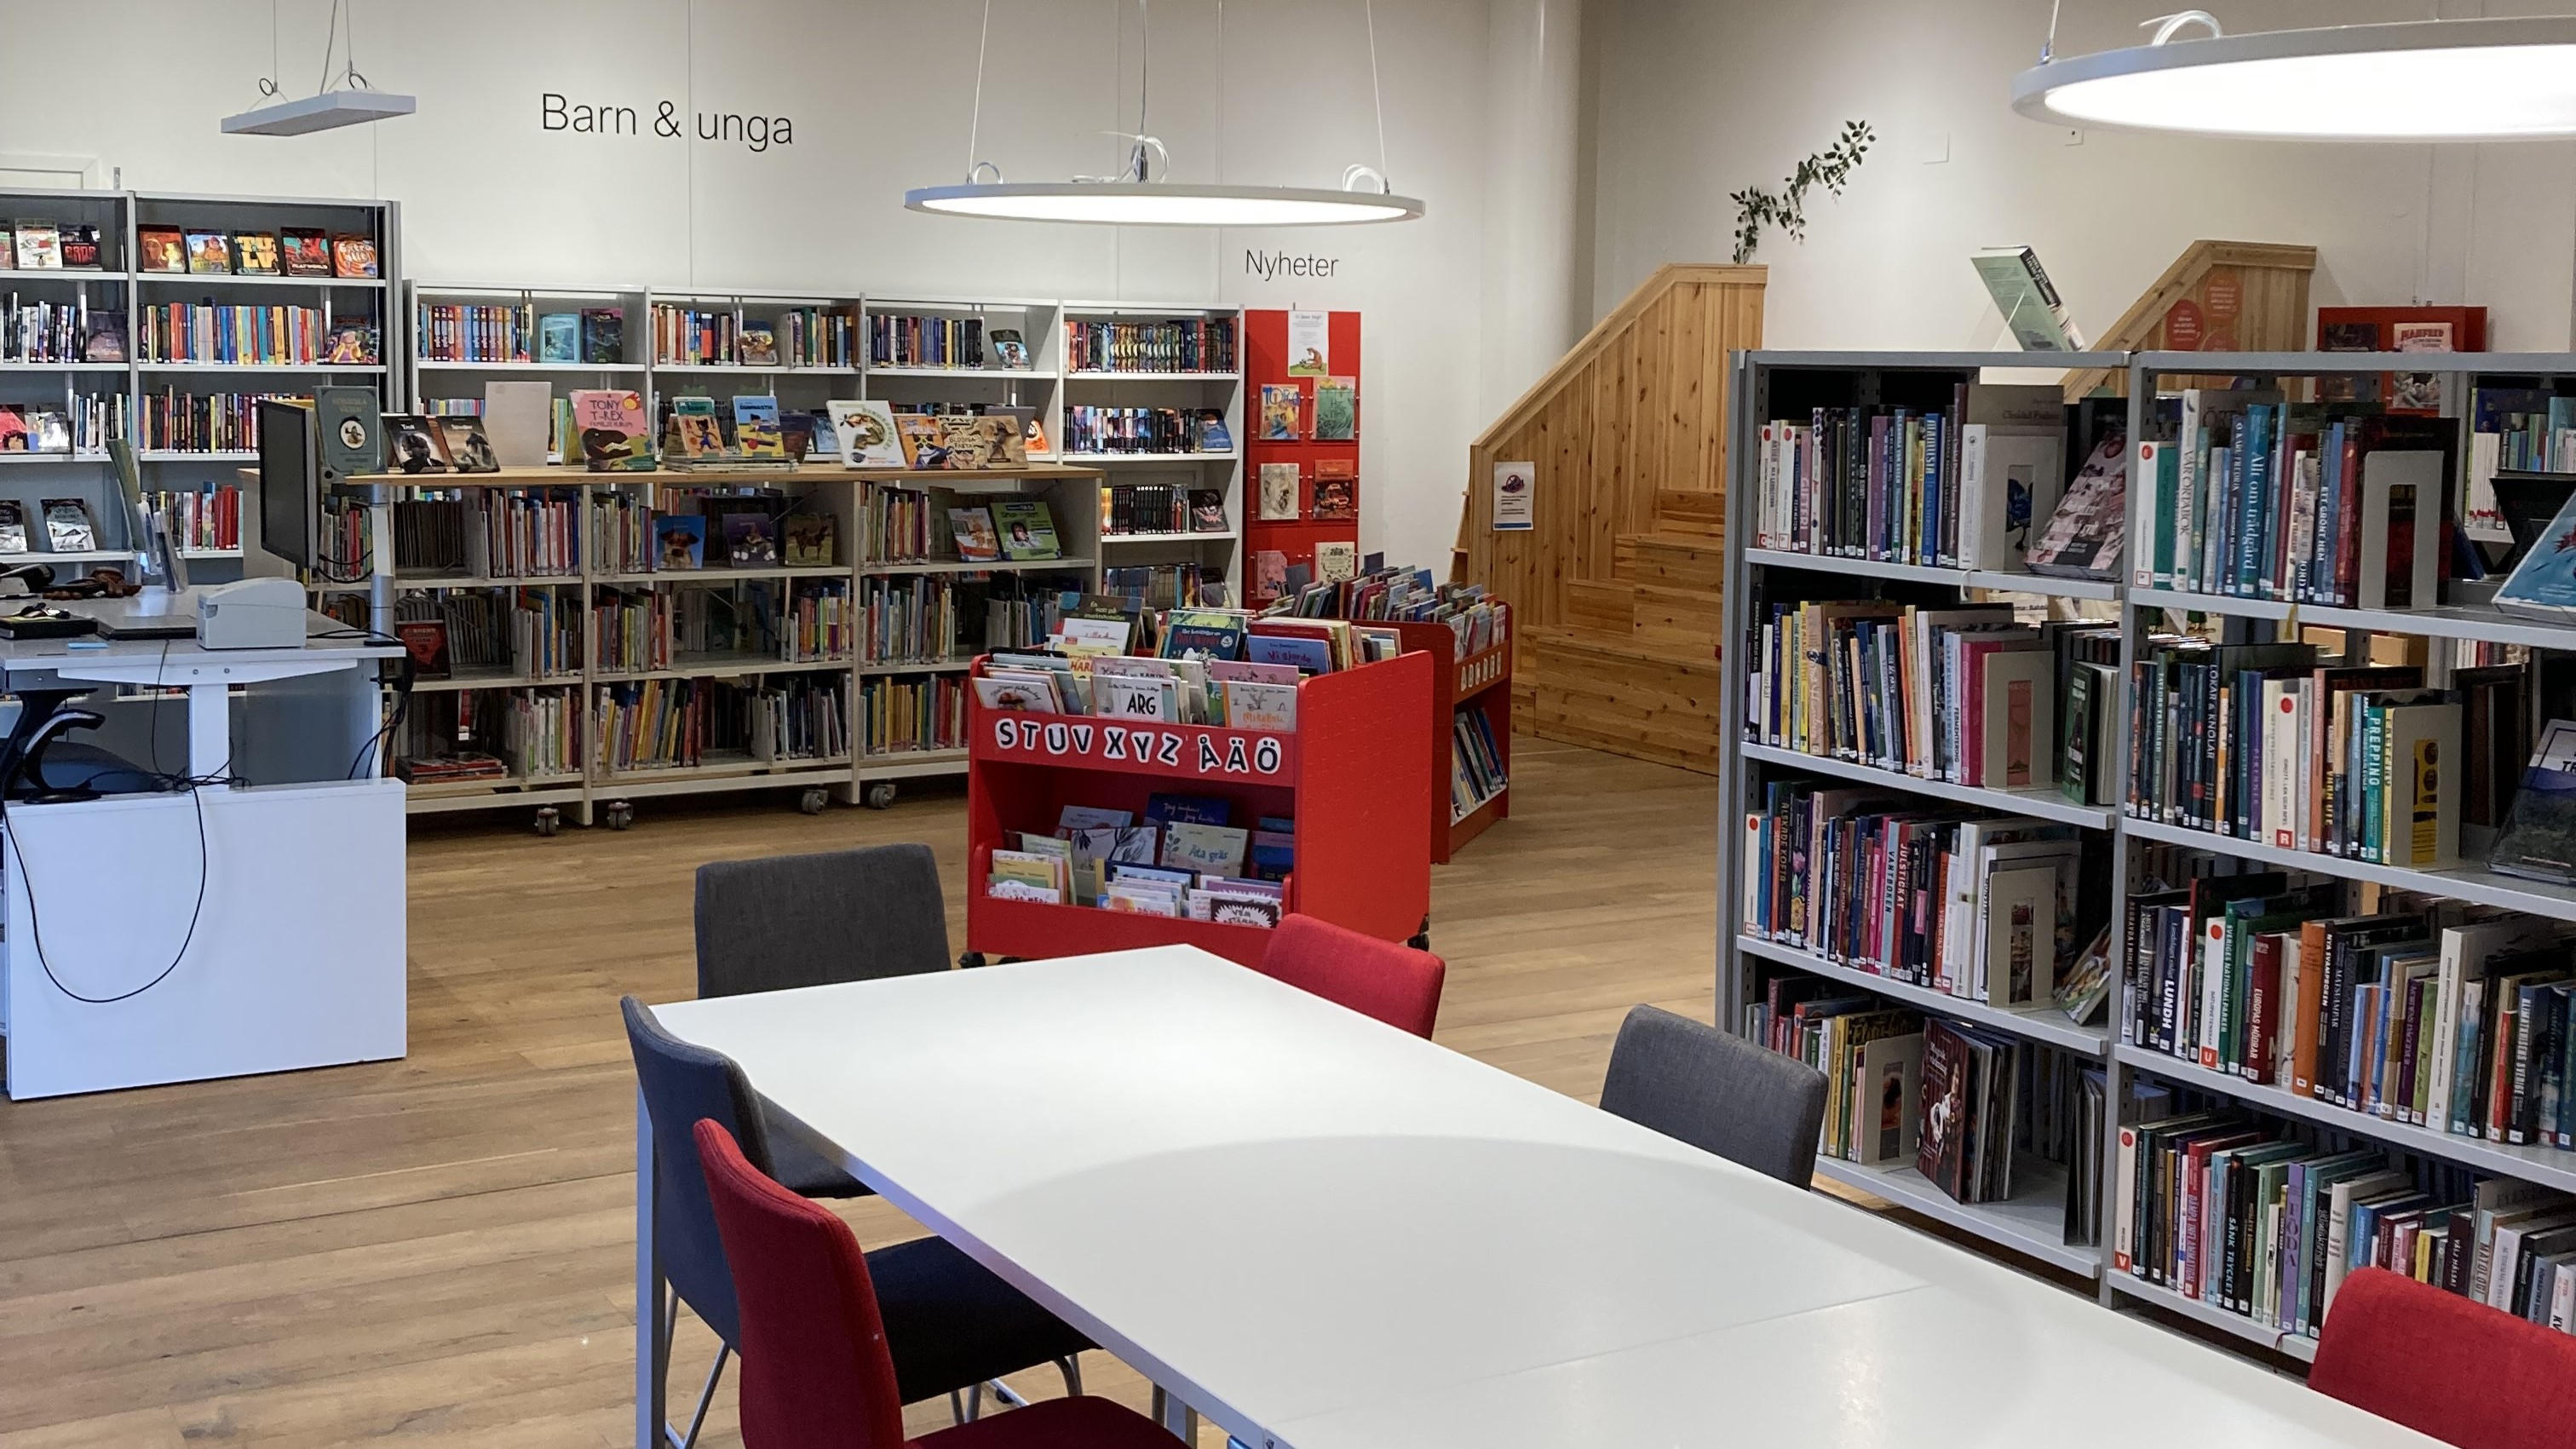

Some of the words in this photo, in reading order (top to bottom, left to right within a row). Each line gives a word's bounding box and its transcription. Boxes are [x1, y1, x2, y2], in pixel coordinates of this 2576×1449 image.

[543, 93, 636, 135] Barn
[653, 100, 681, 137] &
[698, 112, 792, 152] unga
[1245, 249, 1339, 281] Nyheter
[589, 400, 620, 410] TONY
[590, 411, 624, 421] T-REX
[2250, 451, 2265, 479] Allt
[2179, 476, 2194, 536] ÖRTABOK
[2248, 480, 2260, 504] om
[2320, 486, 2329, 503] ETT
[2241, 508, 2260, 570] trädgård
[2317, 505, 2328, 538] GRÖNT
[2316, 540, 2326, 561] HEM
[1126, 692, 1157, 716] ARG
[2369, 717, 2382, 786] PREPPING
[1884, 852, 1895, 914] VANTBOKEN
[1896, 843, 1908, 910] JULSTICKAT
[2224, 923, 2234, 962] SVERIGES
[2322, 952, 2332, 1007] SVAMPBOKEN
[2162, 980, 2175, 1029] LUNDH
[2252, 987, 2263, 1024] EUROPAS
[2332, 969, 2343, 1028] MATSVAMPAR
[2249, 1025, 2262, 1059] MÖDRAR
[2187, 1194, 2199, 1222] DÄMPA
[2226, 1216, 2239, 1247] SÄNK
[2185, 1222, 2198, 1282] INFLAMMATION
[2224, 1251, 2235, 1295] TRYCKET
